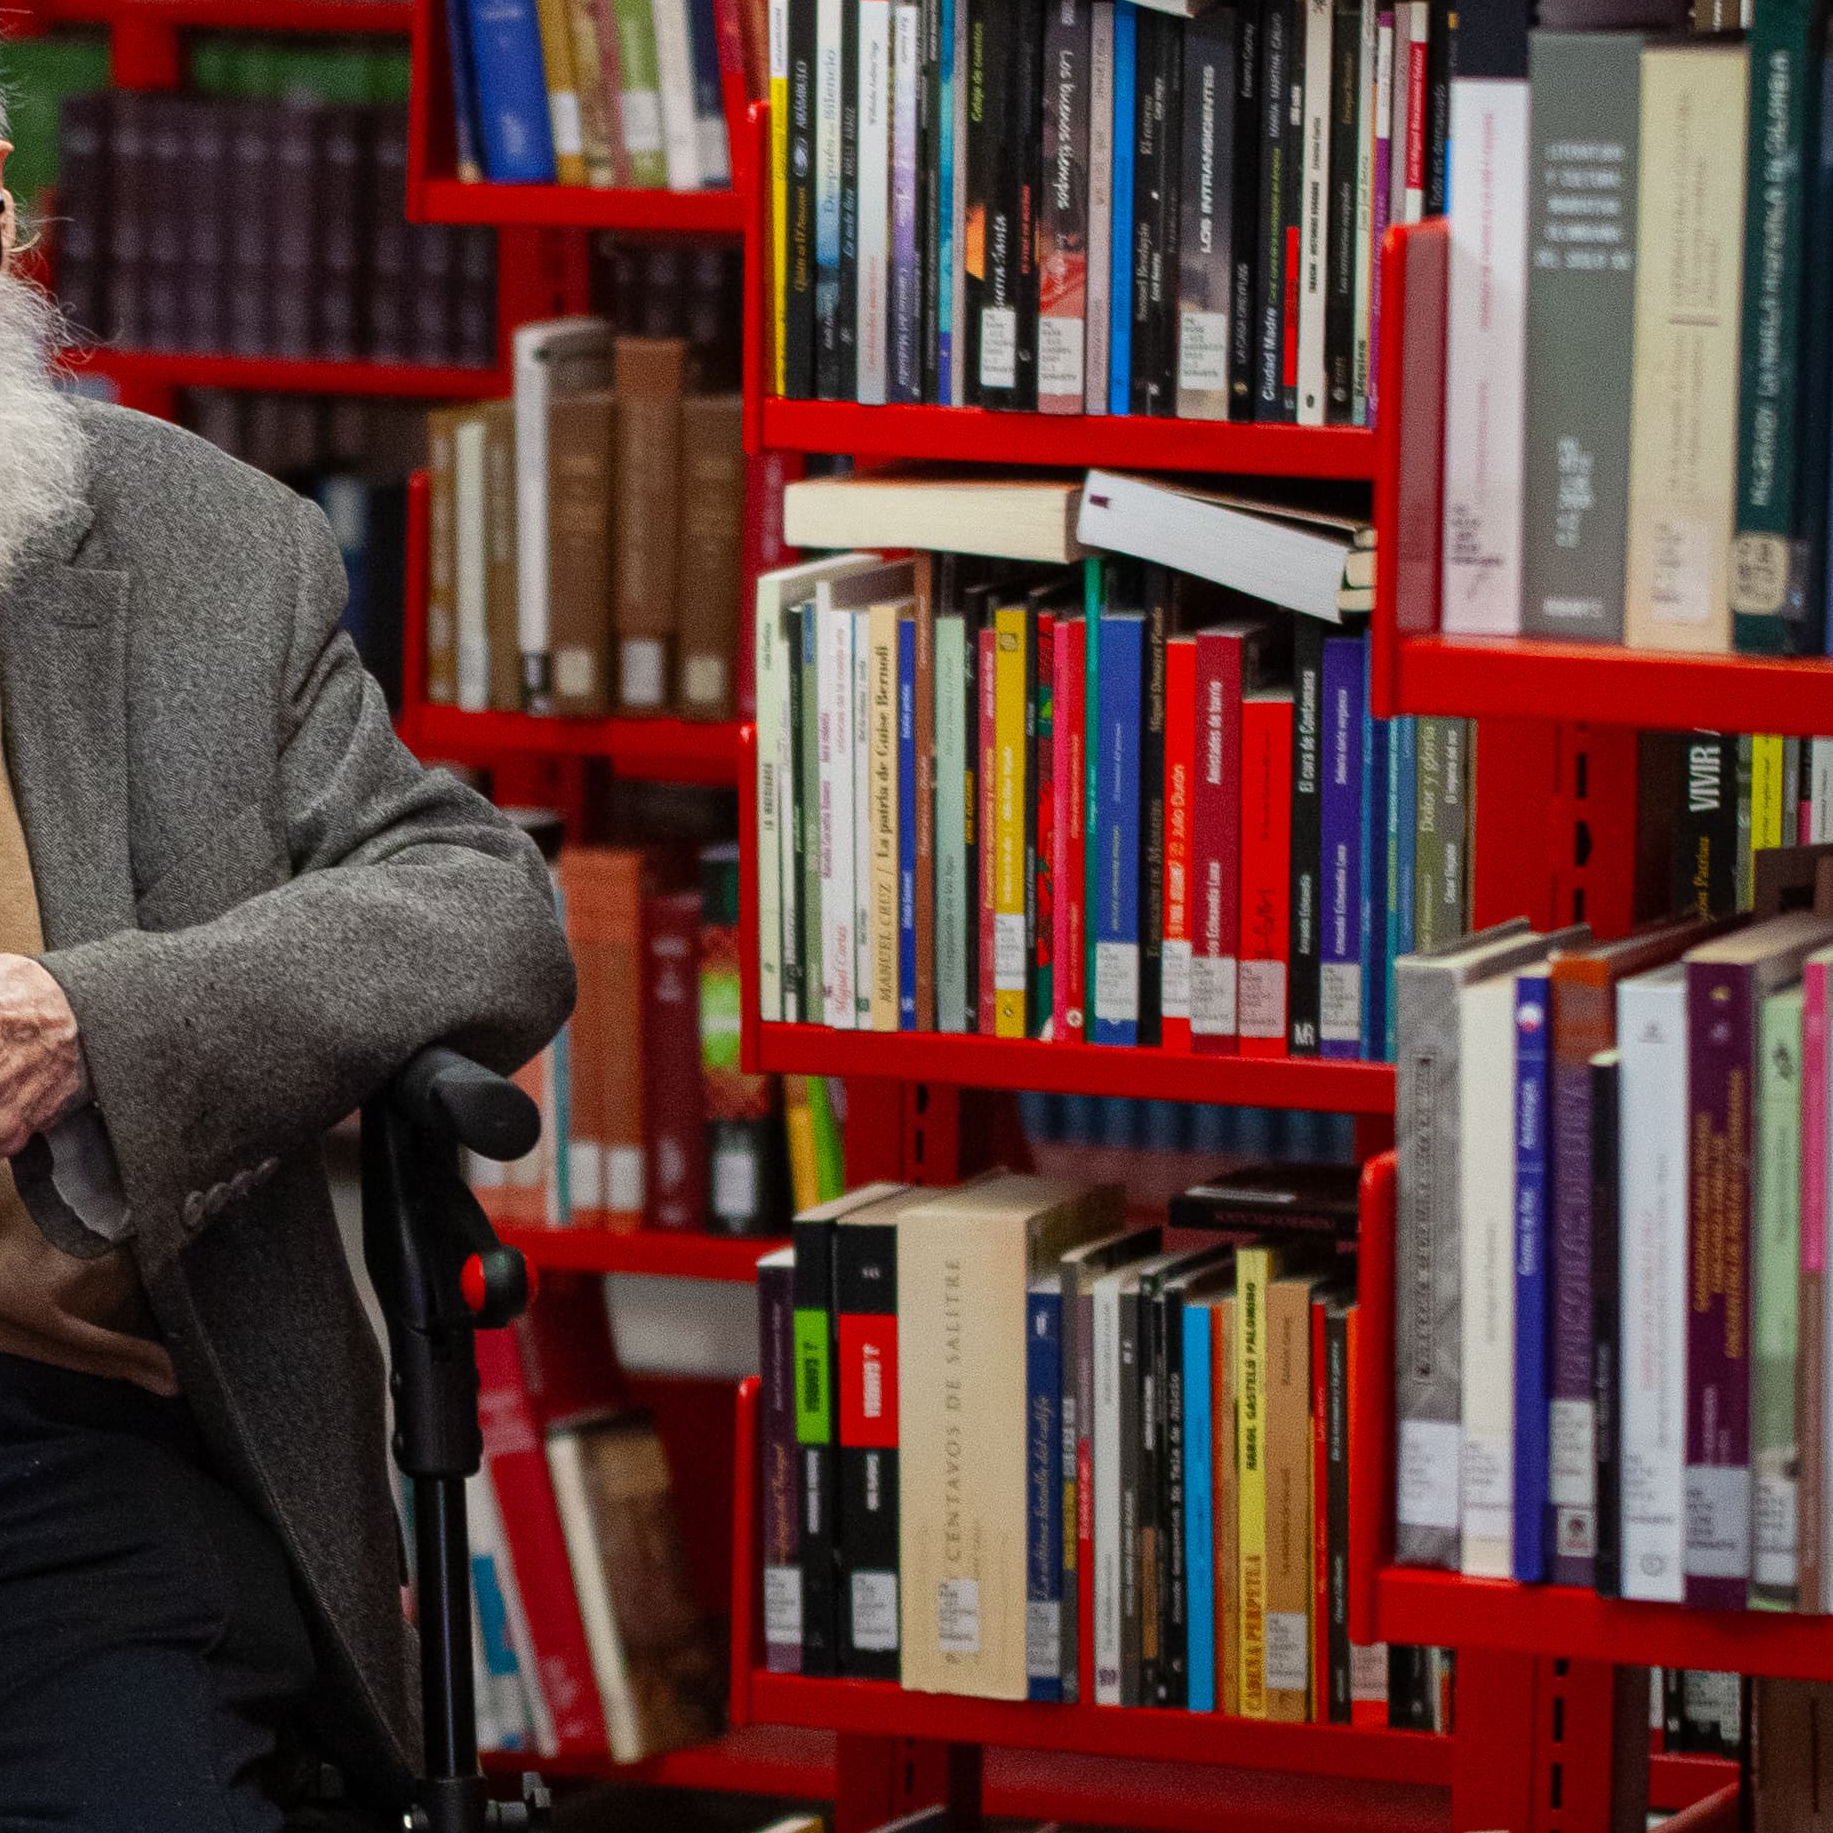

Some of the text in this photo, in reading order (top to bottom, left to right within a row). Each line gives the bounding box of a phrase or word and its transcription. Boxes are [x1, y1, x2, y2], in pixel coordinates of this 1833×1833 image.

[823, 48, 837, 121] Silencio
[822, 143, 840, 214] Después
[1200, 65, 1215, 253] LOS INTRANSIGENTES
[993, 266, 1006, 306] uerra
[1261, 308, 1278, 400] Ciudad Madre
[1207, 680, 1222, 784] Amistades de barrio
[1298, 670, 1315, 792] El cura de Contamana
[876, 762, 889, 781] de
[1422, 726, 1437, 831] Dolor y gloria
[1688, 744, 1722, 812] VIVIR
[876, 786, 890, 833] patria
[876, 838, 890, 858] La
[877, 883, 892, 927] CRUZ
[877, 931, 893, 1003] MANUEL
[944, 1258, 959, 1562] CENTAVOS DE SALITRE
